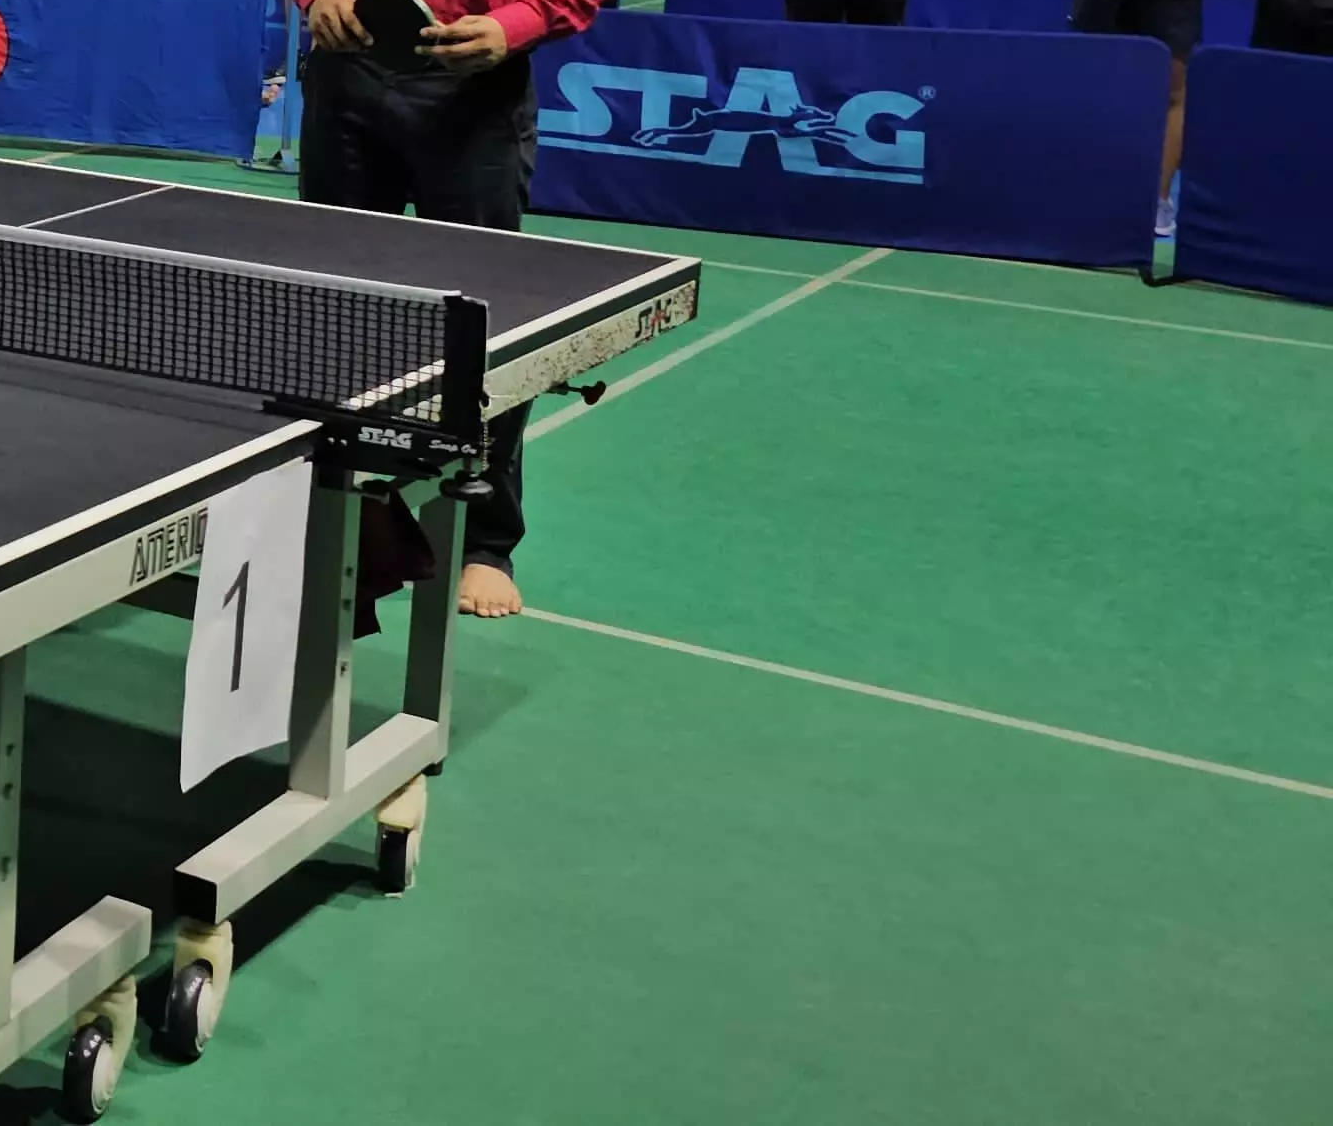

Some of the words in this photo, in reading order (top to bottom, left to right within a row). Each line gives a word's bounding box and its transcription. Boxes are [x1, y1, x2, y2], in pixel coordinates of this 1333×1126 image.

[536, 61, 926, 185] STAG
[357, 426, 413, 450] STAG
[129, 506, 209, 587] AMERIC
[221, 559, 250, 693] 1
